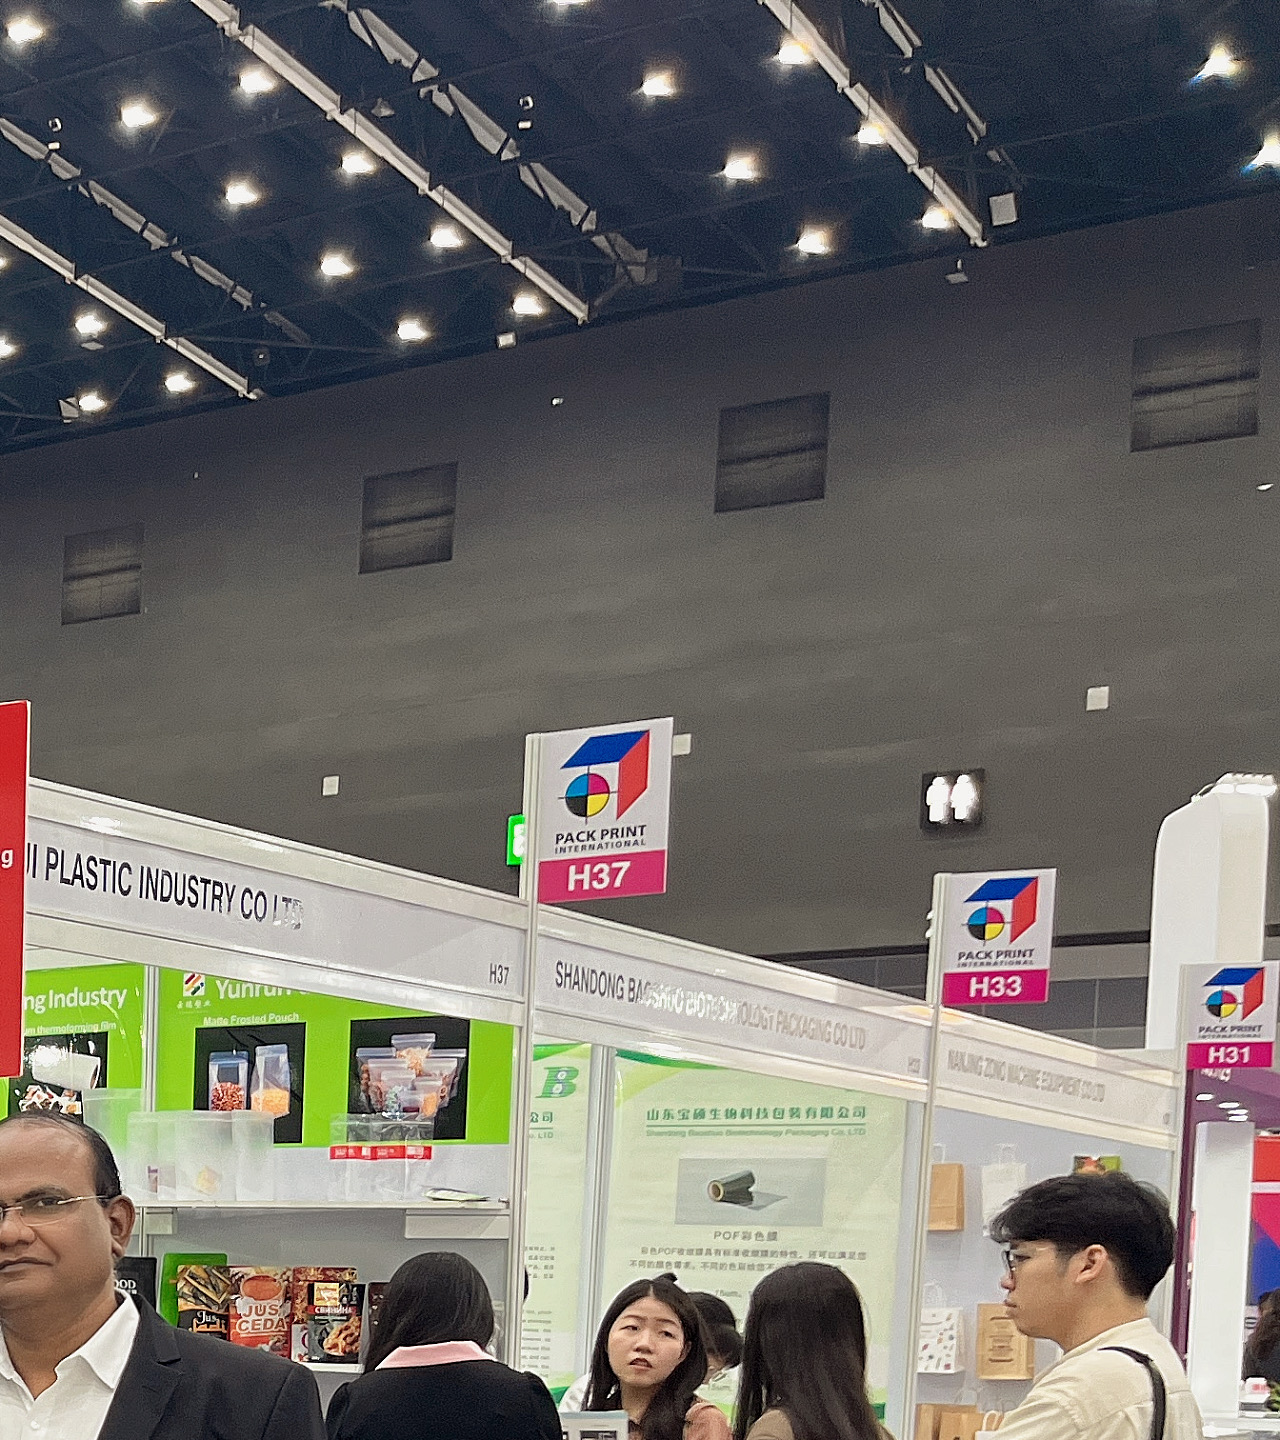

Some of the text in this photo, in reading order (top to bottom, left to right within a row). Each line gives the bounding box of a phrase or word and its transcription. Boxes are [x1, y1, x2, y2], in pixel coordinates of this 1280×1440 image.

[555, 825, 647, 846] PACK PRINT
[555, 837, 647, 855] INTERNATIONAL
[567, 861, 631, 893] H37
[45, 847, 510, 987] PLASTIC INDUSTRY CO LTD H37
[958, 948, 1035, 962] PACK PRINT
[555, 959, 624, 1002] SHANDONG
[969, 975, 1022, 998] H33
[48, 986, 128, 1009] Industry
[100, 1021, 116, 1031] film
[203, 1012, 299, 1026] Matte Frosted Pouch
[1208, 1045, 1251, 1064] H31
[243, 1303, 280, 1317] JUS
[236, 1316, 289, 1333] CEDA
